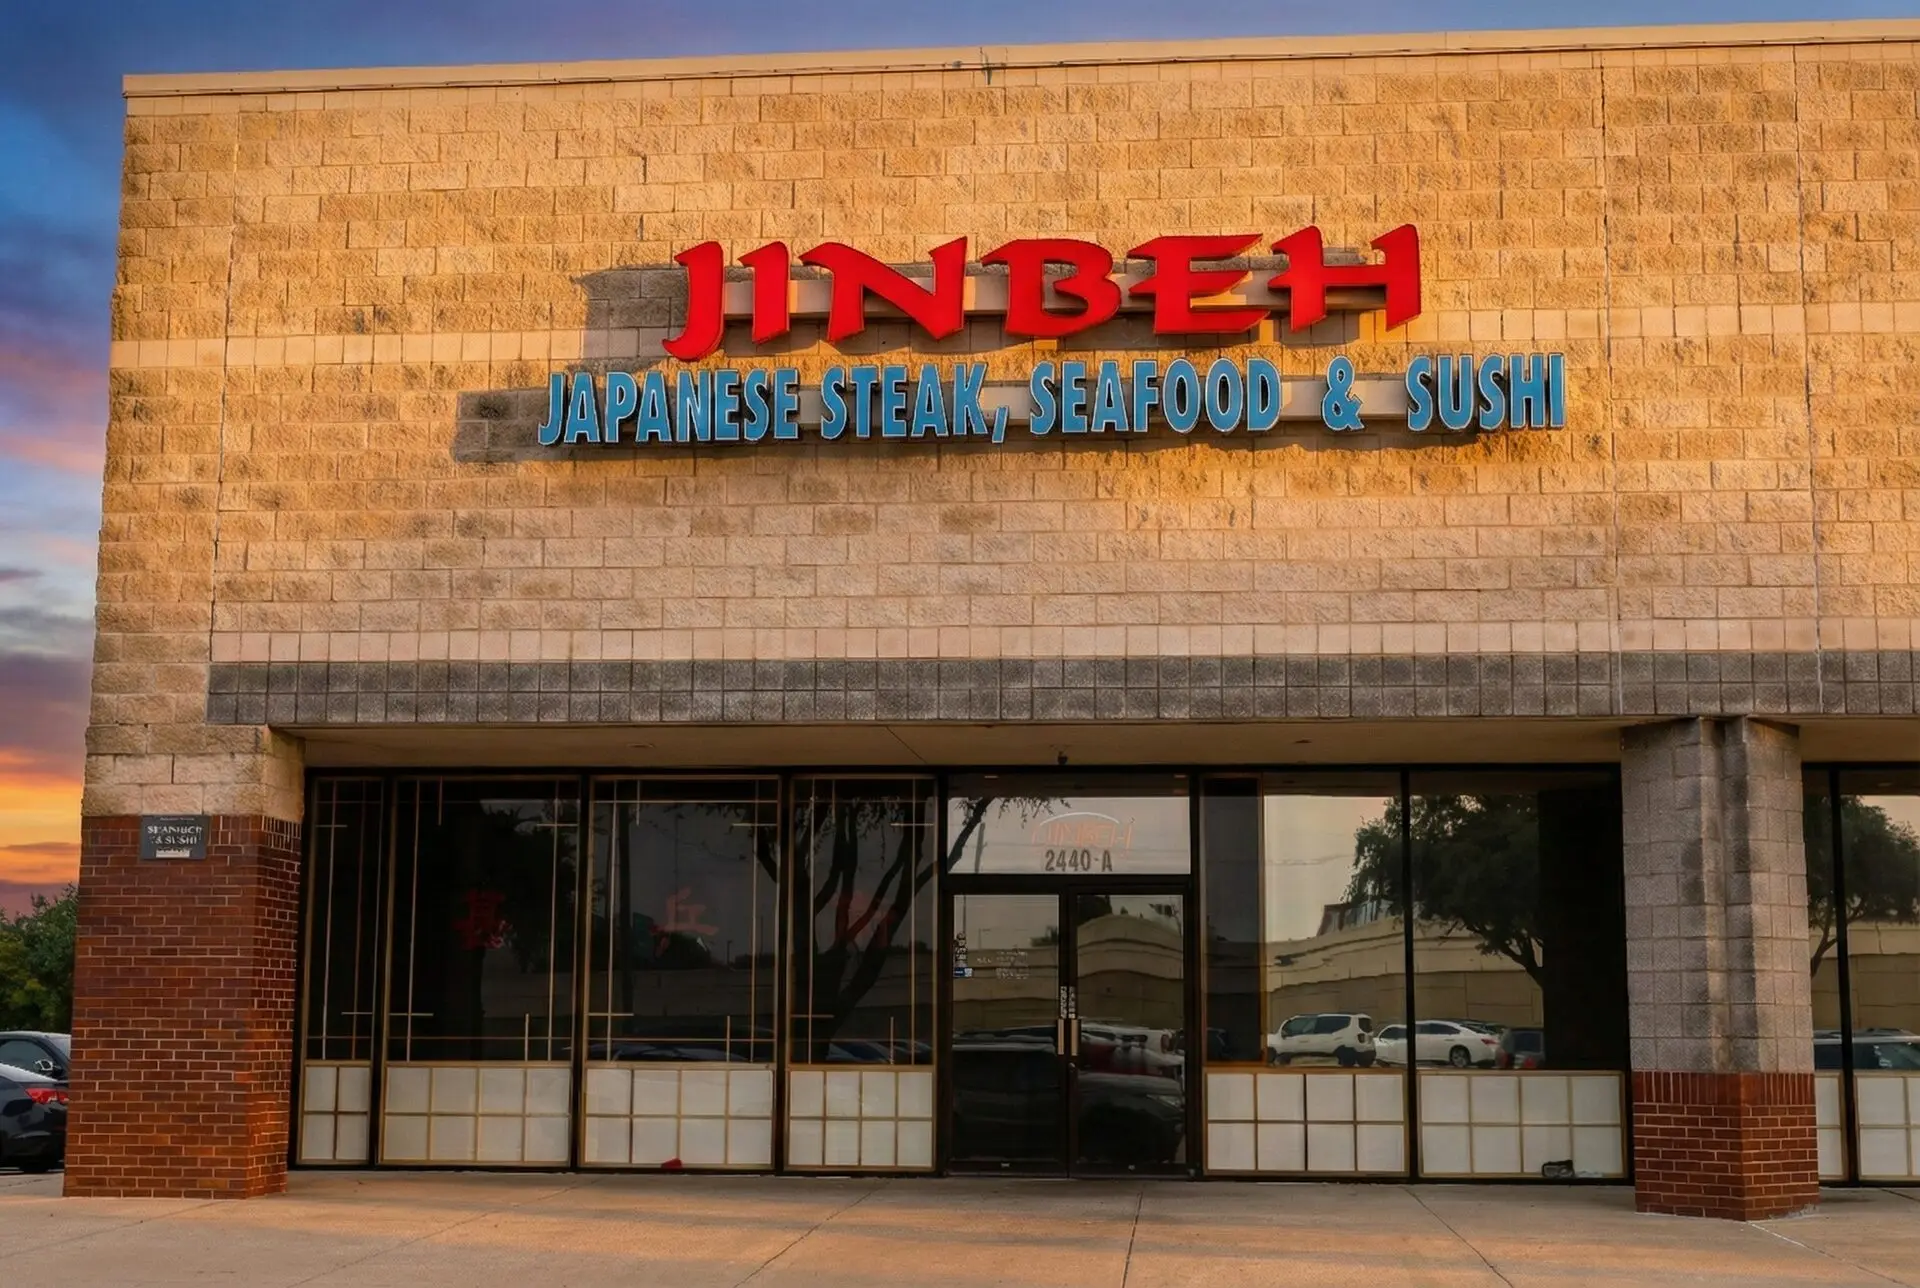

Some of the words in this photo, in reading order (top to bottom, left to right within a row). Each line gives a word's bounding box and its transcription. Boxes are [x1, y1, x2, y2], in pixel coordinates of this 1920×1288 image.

[662, 223, 1421, 361] JINBEH
[537, 366, 799, 445] JAPANESE
[820, 361, 1009, 443] STEAK,
[1029, 357, 1282, 436] SEAFOOD
[1321, 355, 1365, 432] &
[1406, 352, 1567, 432] SUSHI
[1045, 850, 1113, 872] 2440-A
